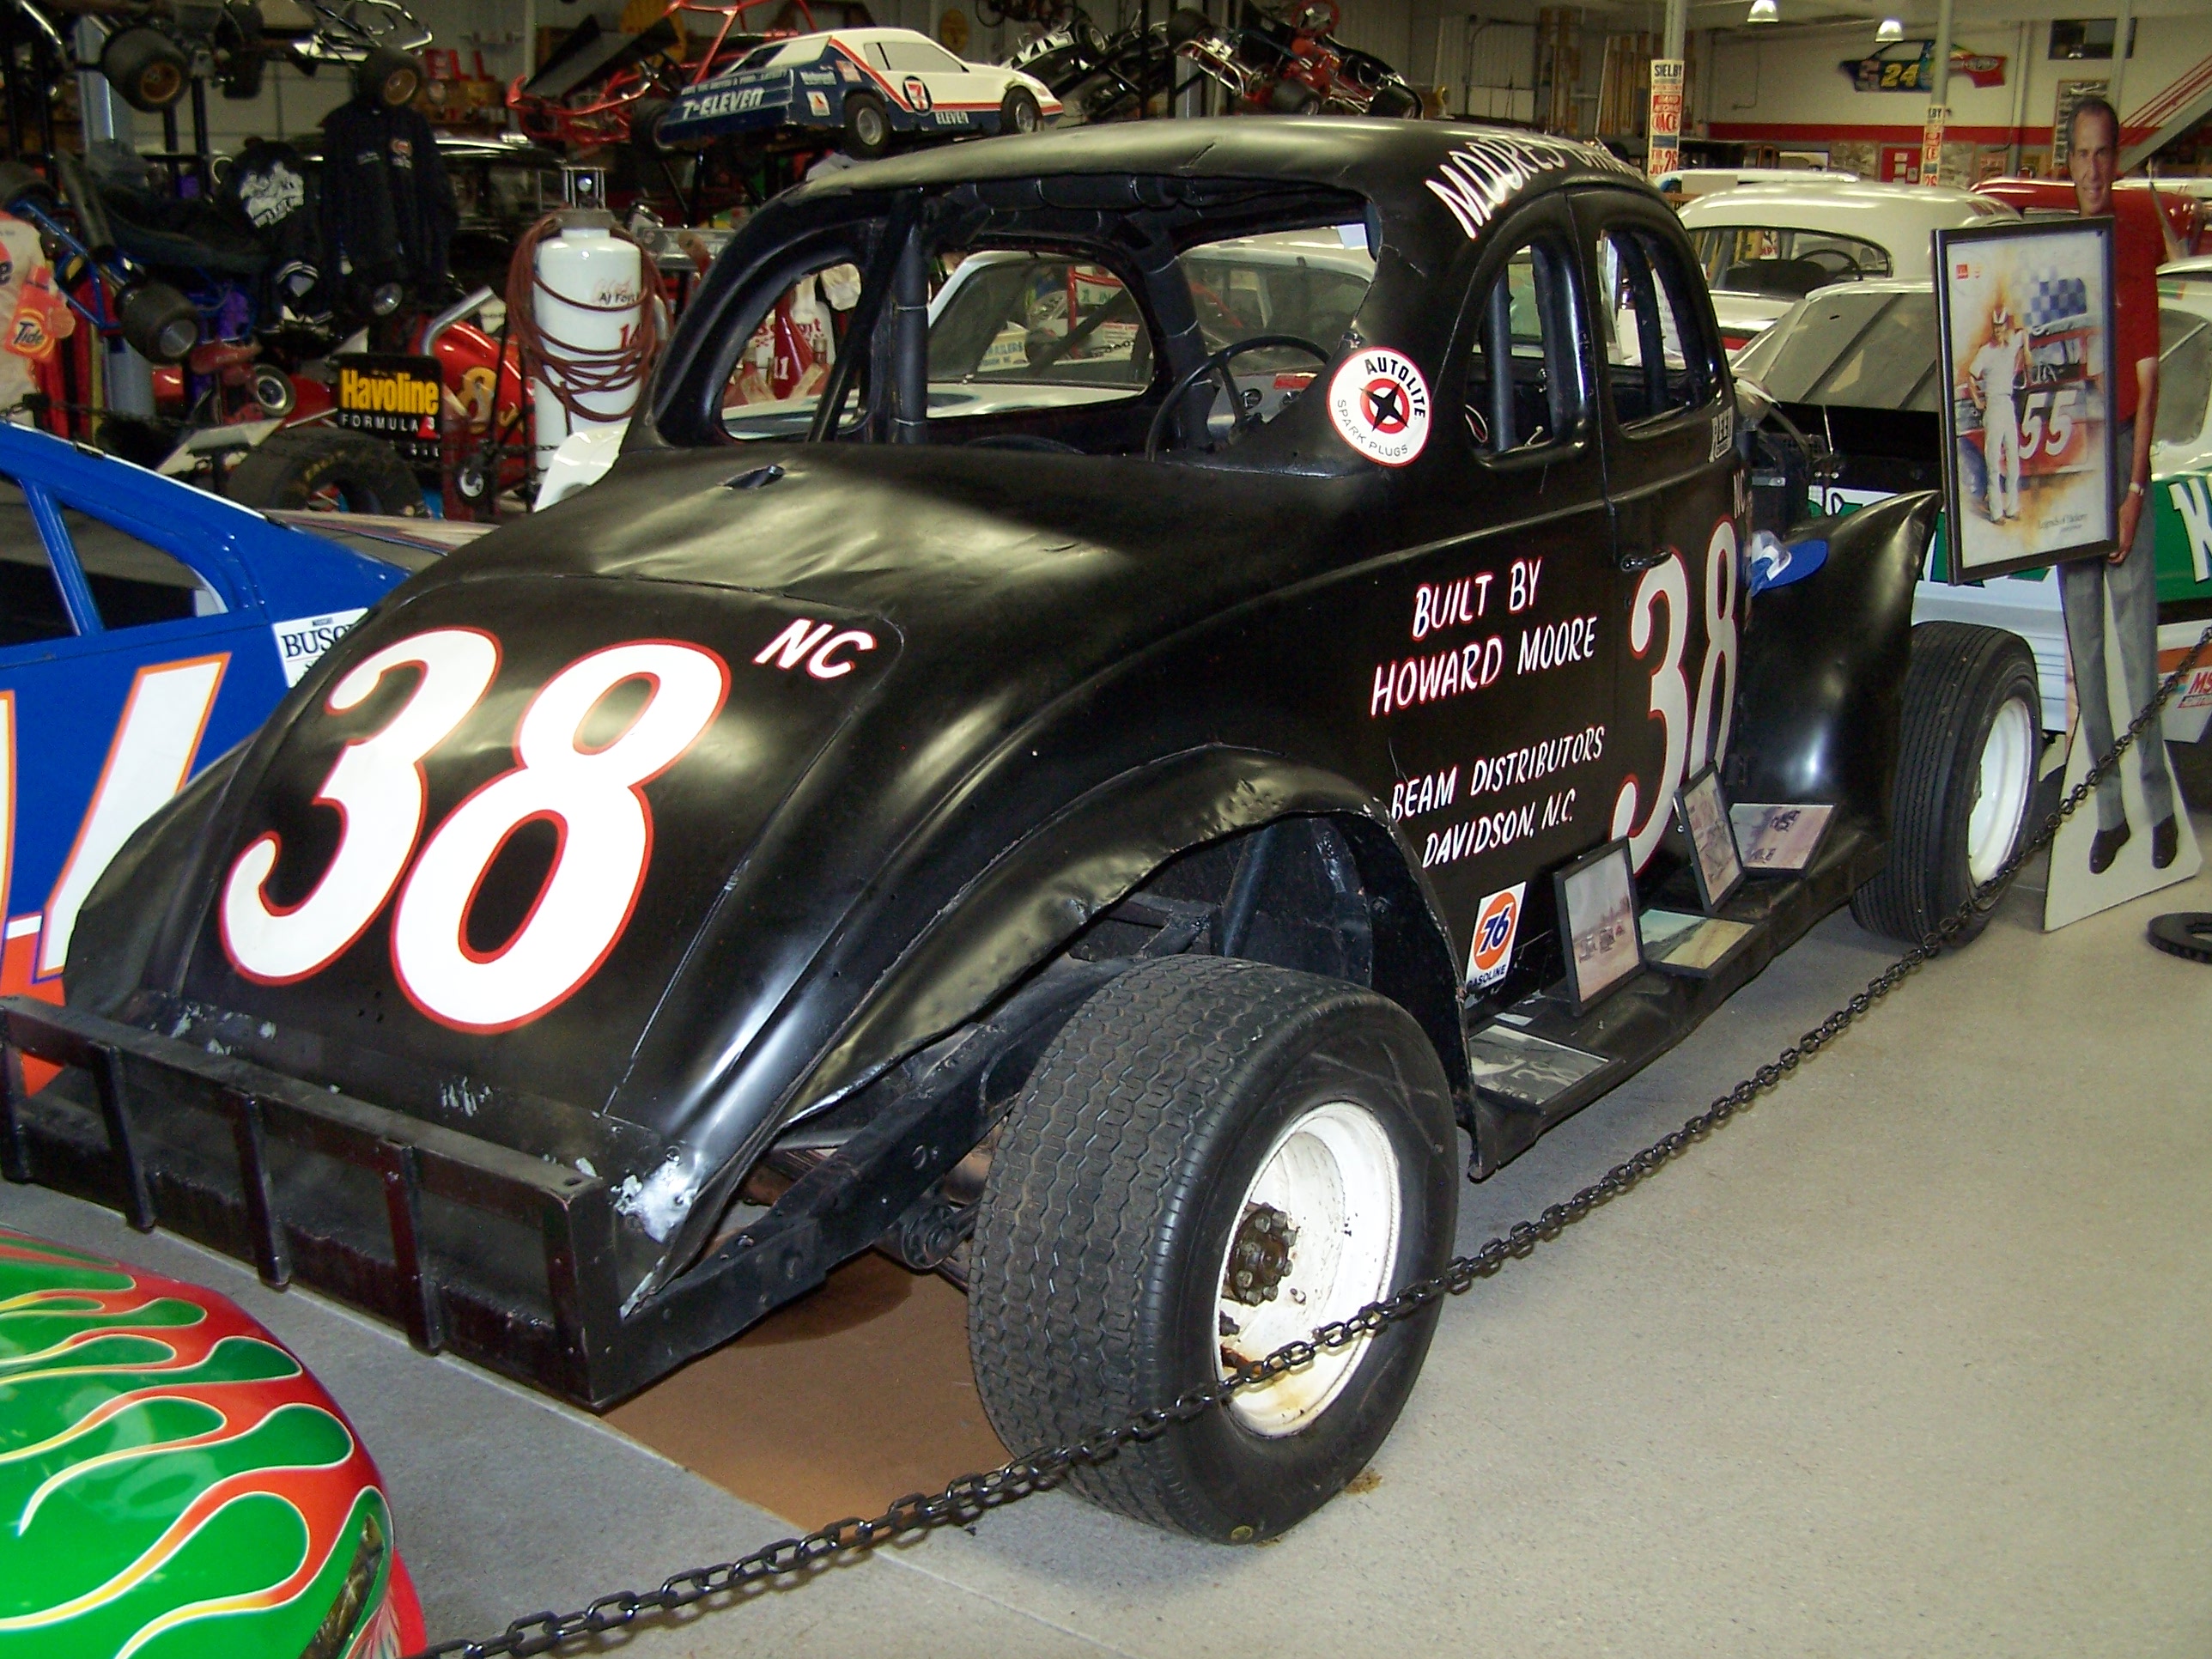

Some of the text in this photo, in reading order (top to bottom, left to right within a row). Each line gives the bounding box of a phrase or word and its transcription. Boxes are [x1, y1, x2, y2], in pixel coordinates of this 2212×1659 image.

[1654, 64, 1682, 77] SHELBY
[1880, 63, 1920, 88] 24
[14, 320, 43, 345] Tide
[340, 368, 440, 416] Havoline
[1364, 356, 1426, 419] AUTOLITE
[342, 413, 419, 432] FORMULA
[1337, 398, 1408, 457] SPARK PLUGS
[2019, 389, 2078, 461] 55
[1412, 557, 1543, 640] BUILT BY
[750, 617, 878, 681] NC
[1370, 616, 1598, 717] HOWARD MOORE
[1609, 518, 1739, 878] 38
[1391, 725, 1606, 823] BEAM DISTRIBUTORS
[220, 625, 732, 1034] 38
[1422, 788, 1577, 869] DAVIDSON, N.C.
[1476, 902, 1514, 957] 76
